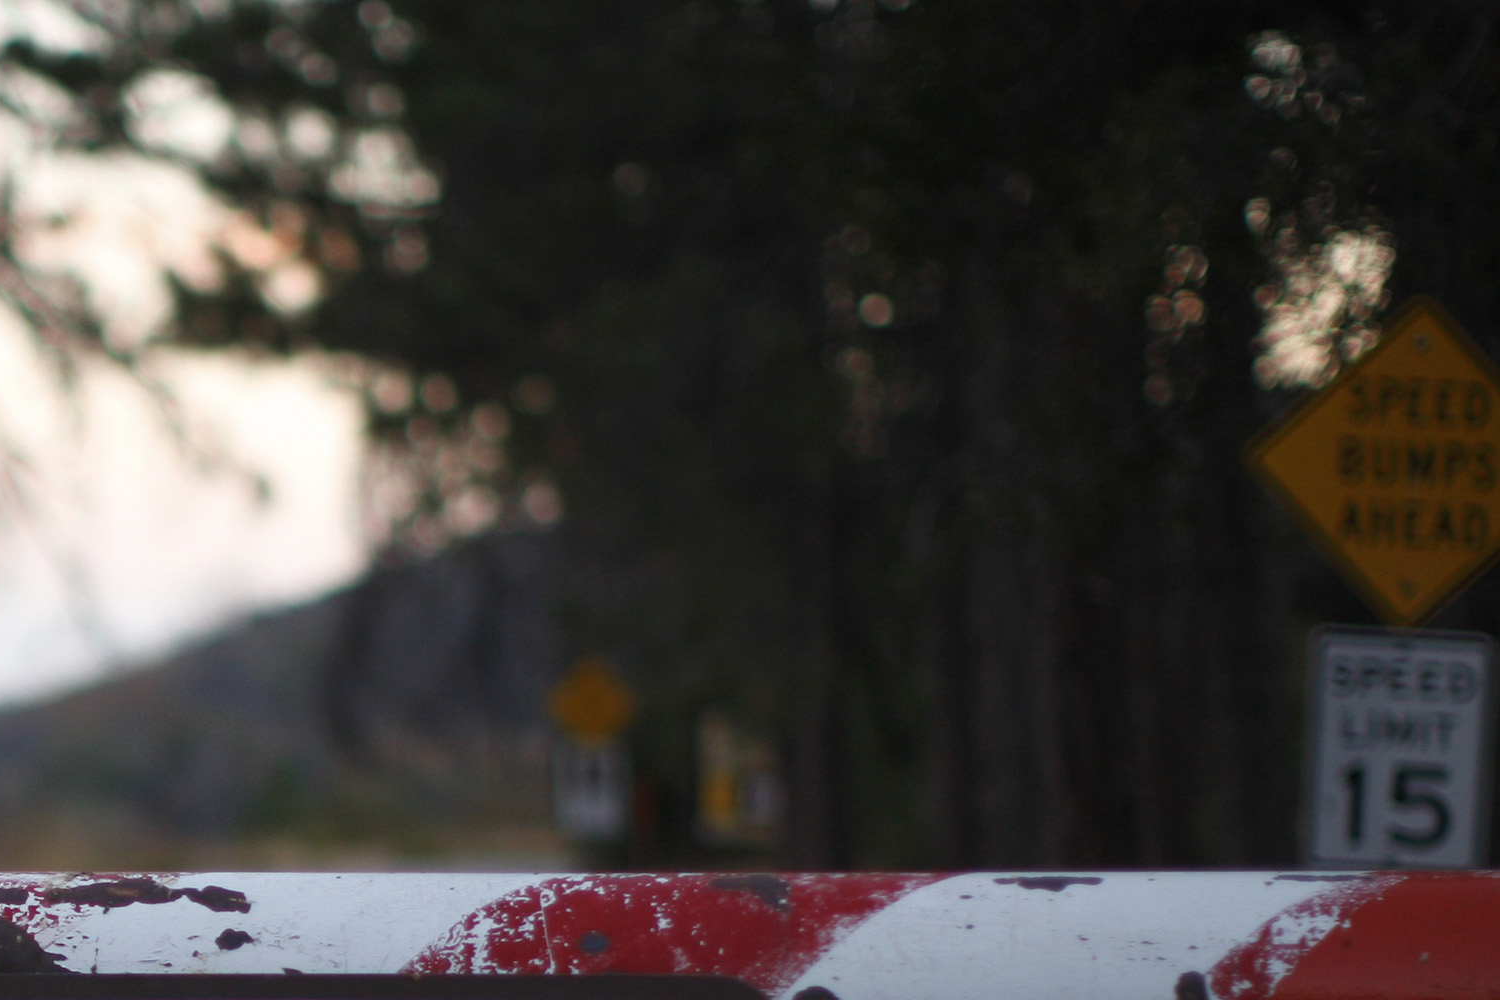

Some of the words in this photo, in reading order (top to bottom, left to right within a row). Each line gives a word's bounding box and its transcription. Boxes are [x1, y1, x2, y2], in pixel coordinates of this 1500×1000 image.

[1348, 376, 1492, 430] SPEED
[1338, 434, 1498, 492] BUMPS
[1338, 498, 1490, 549] AHEAD
[1331, 656, 1477, 702] SPEED
[1340, 709, 1456, 749] LIMIT
[1342, 762, 1451, 852] 15
